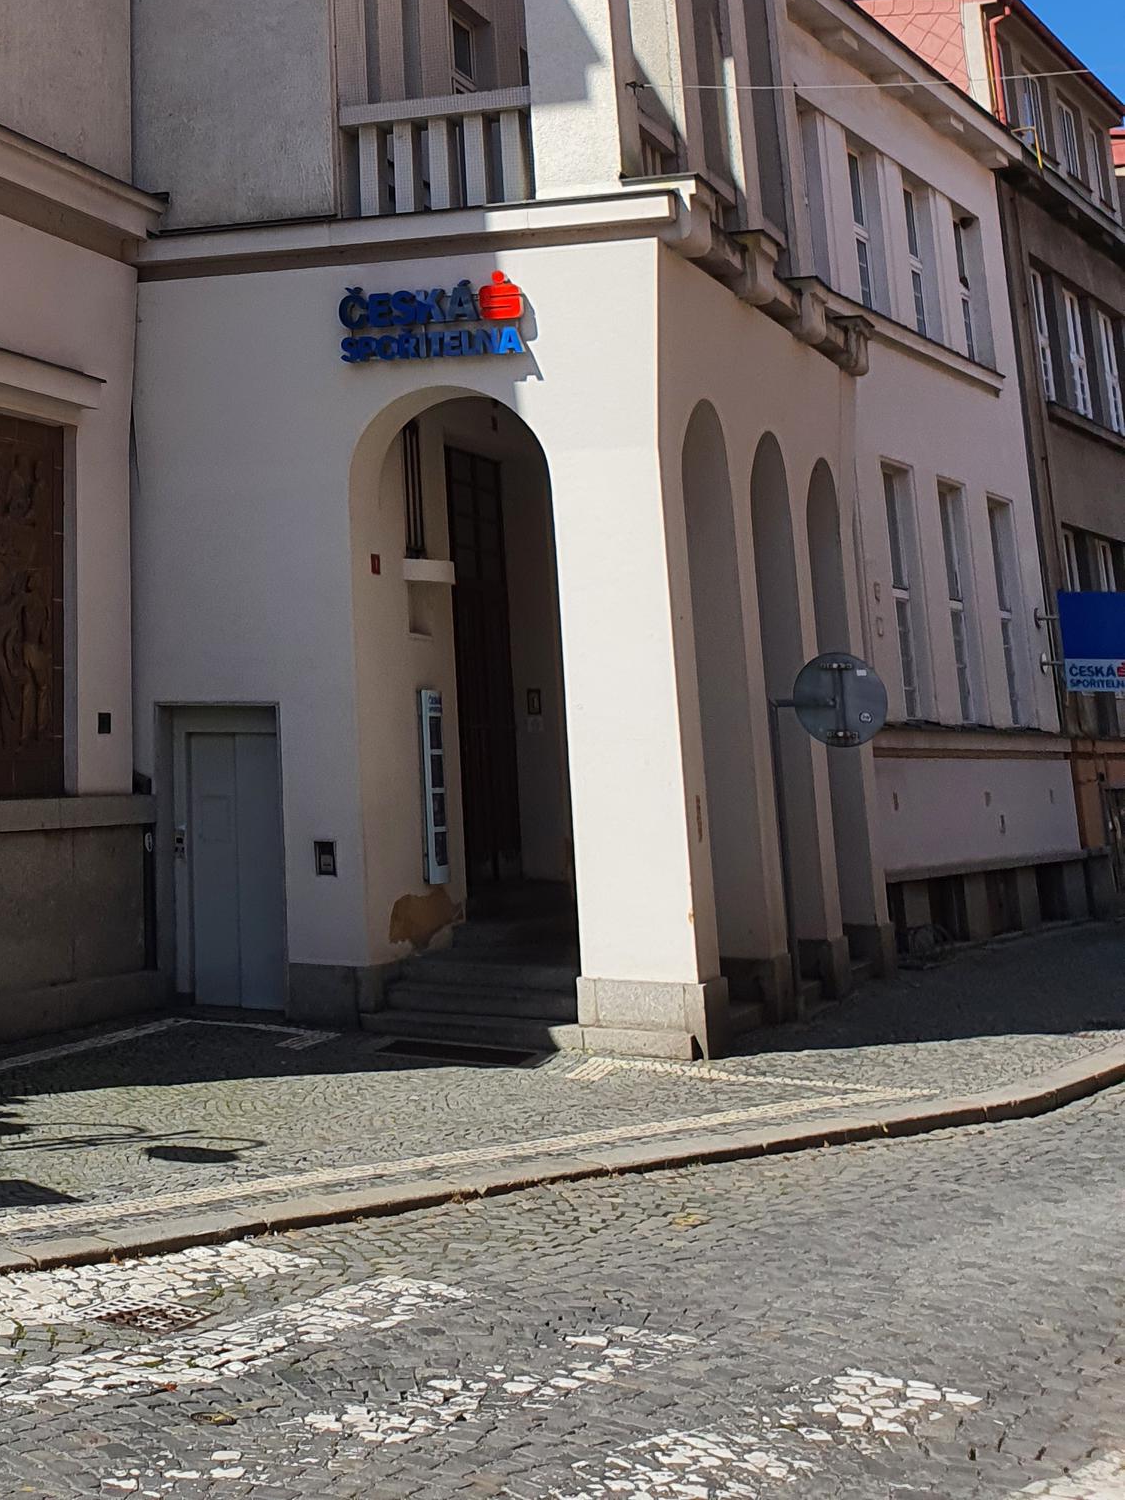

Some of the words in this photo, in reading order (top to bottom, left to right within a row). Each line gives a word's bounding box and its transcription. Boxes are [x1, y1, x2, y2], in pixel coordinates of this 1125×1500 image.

[339, 279, 481, 329] ČESKÁ
[341, 326, 524, 363] SPOŘITELNA
[1069, 663, 1116, 677] ČESKÁ
[1070, 678, 1125, 688] SPOŘITELN
